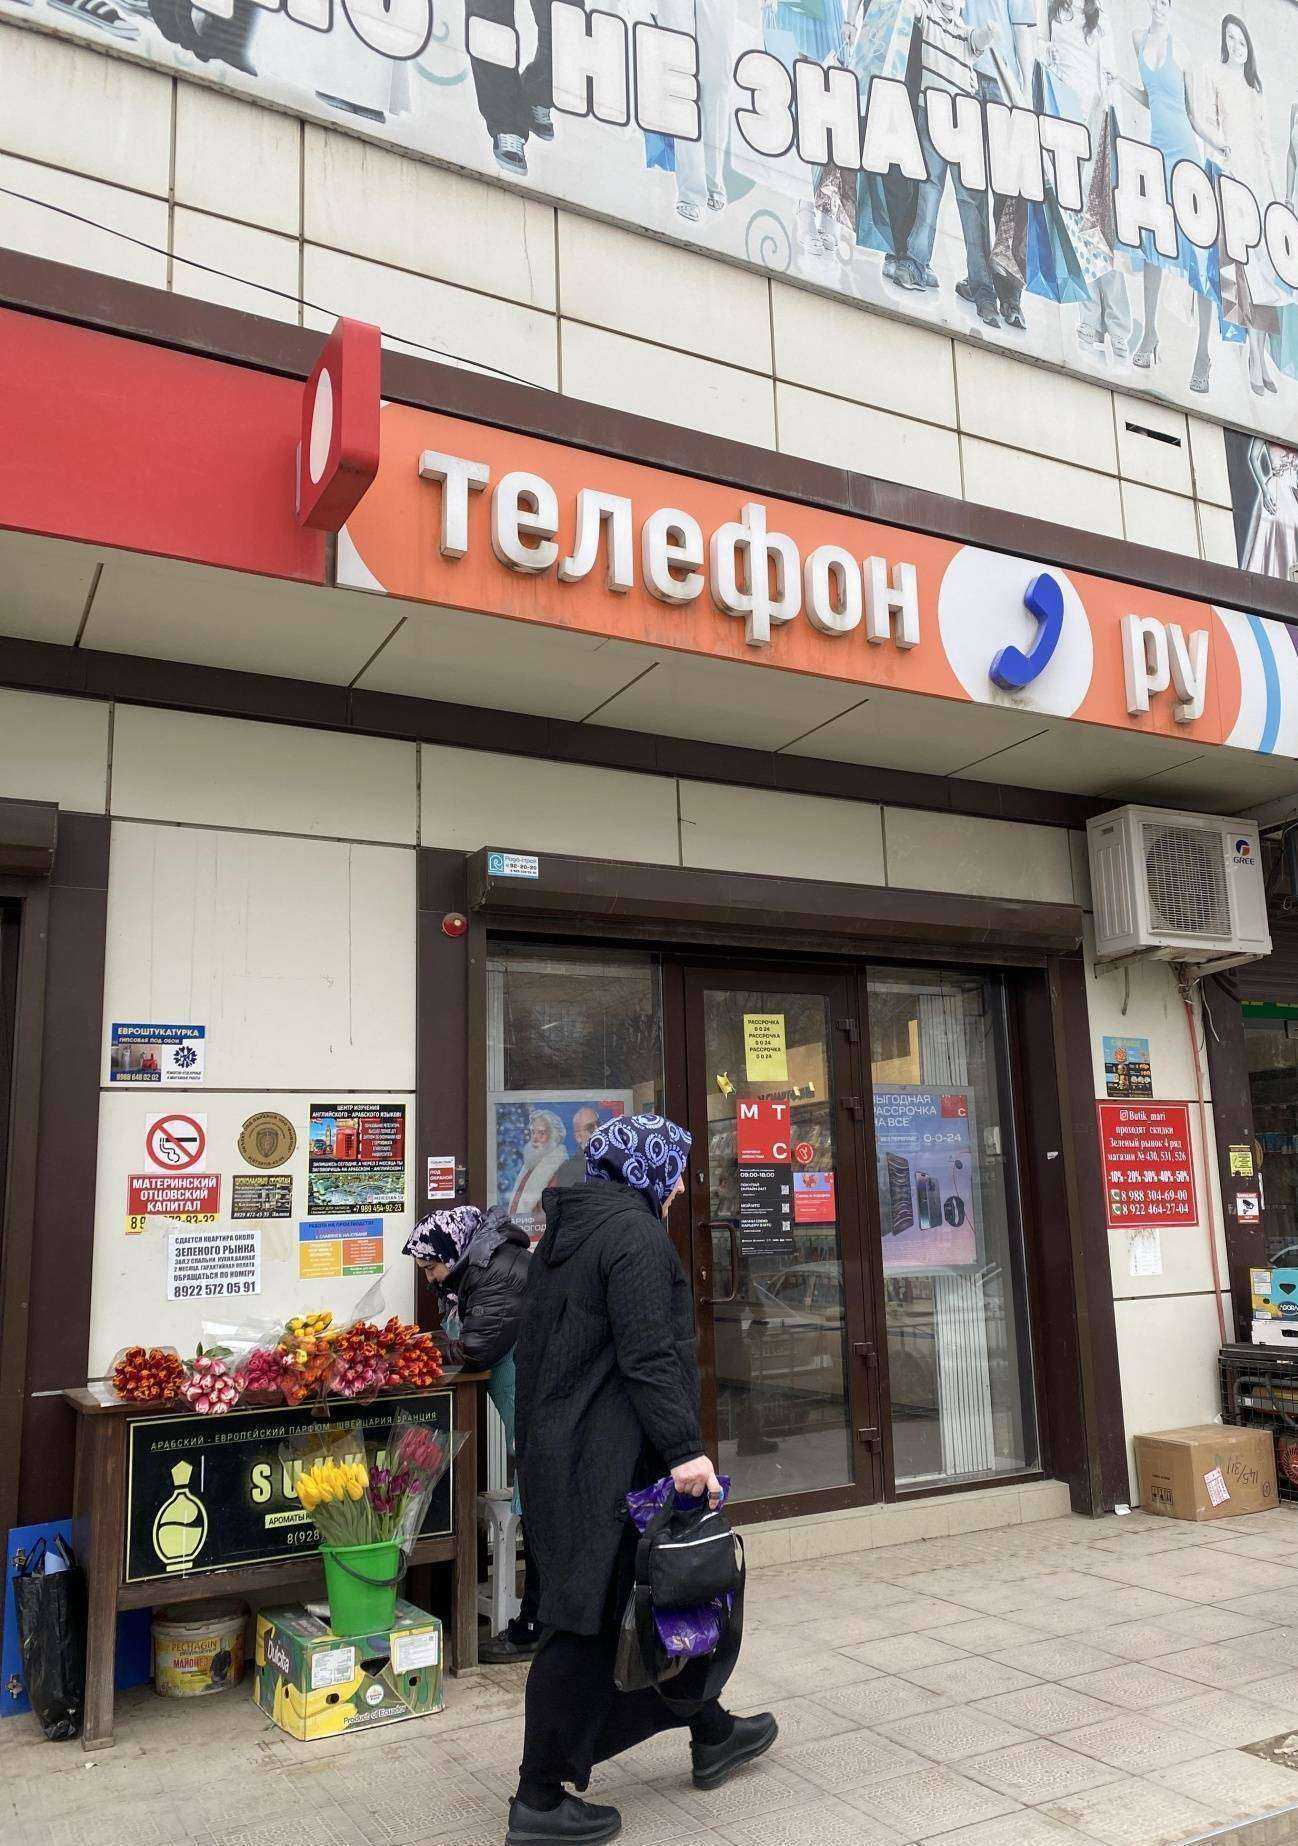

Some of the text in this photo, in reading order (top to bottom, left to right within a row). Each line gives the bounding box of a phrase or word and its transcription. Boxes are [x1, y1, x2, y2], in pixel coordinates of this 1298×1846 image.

[550, 0, 701, 142] НЕ
[733, 48, 1092, 213] ЗНАЧИТ
[418, 448, 1209, 724] телефон ру
[1233, 856, 1255, 866] GREE
[117, 1027, 200, 1037] ЕВРОШТУКАТУРКА
[132, 1177, 217, 1189] МАТЕРИНСКИЙ
[140, 1188, 208, 1201] ОТЦОВСКИЙ
[147, 1200, 201, 1212] КАПИТАЛ
[1130, 1204, 1146, 1215] 922
[510, 1217, 535, 1225] АРИФ
[174, 1233, 255, 1245] СДАЕТСЯ КВАРТИРА ОКОЛО
[175, 1244, 256, 1258] ЗЕЛЕНОГО РЫНКА
[173, 1269, 256, 1282] ОБРАЩАТЬСЯ ПО НОМЕРУ
[174, 1280, 256, 1298] 8922 572 05 91
[150, 1436, 204, 1451] АРАБСКИЙ
[214, 1427, 286, 1444] ЕВРОПЕЙСКИЙ
[289, 1422, 331, 1434] ПАРФЮМ
[336, 1416, 393, 1431] ШВЕЙЦАРИЯ
[268, 1513, 306, 1526] АРОМАТЫ
[287, 1528, 324, 1546] 8(928
